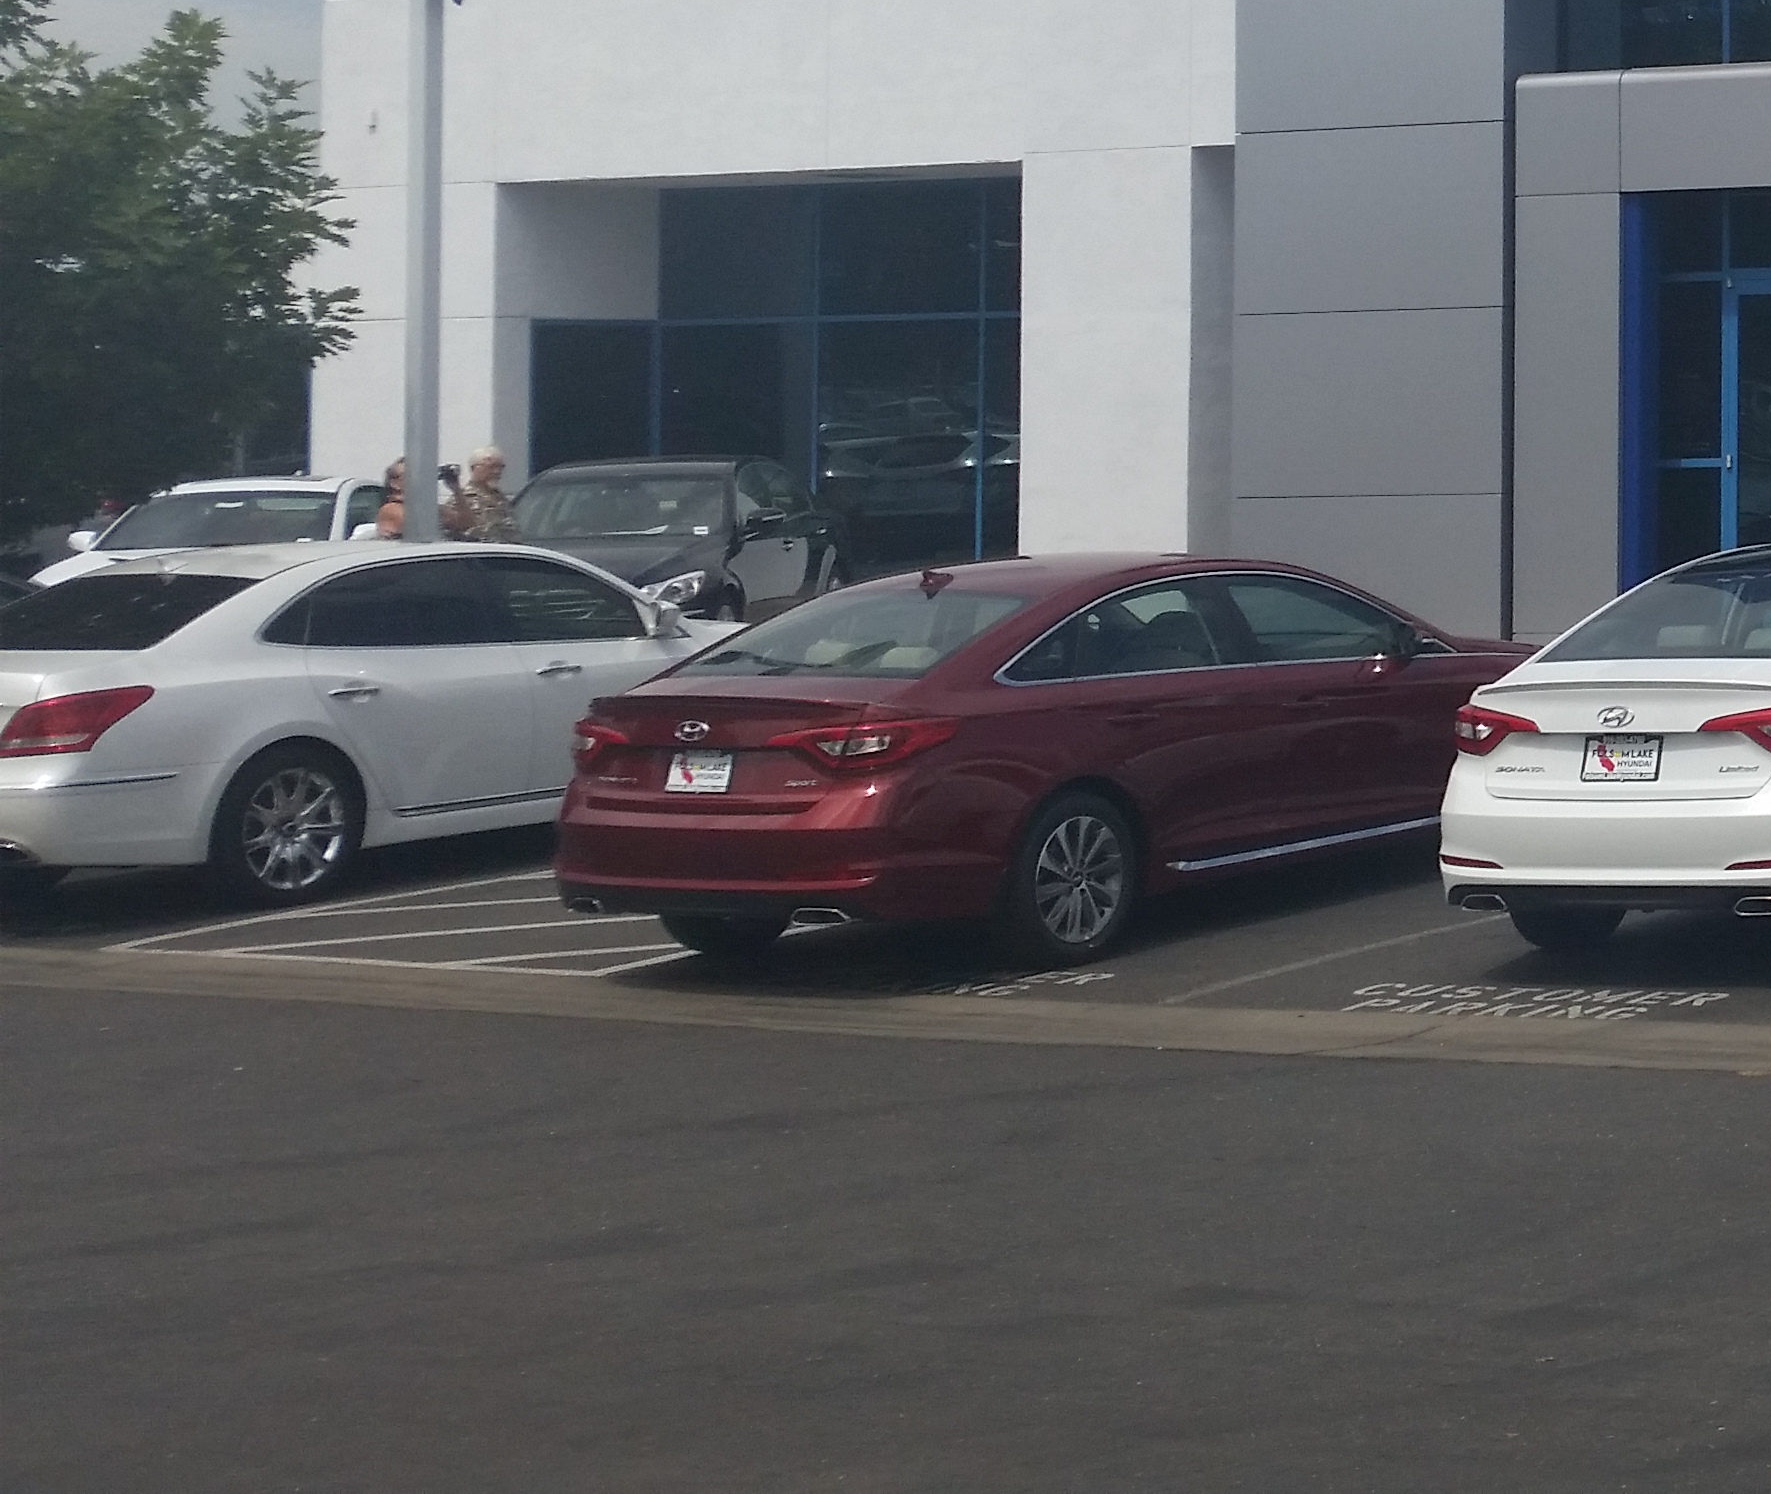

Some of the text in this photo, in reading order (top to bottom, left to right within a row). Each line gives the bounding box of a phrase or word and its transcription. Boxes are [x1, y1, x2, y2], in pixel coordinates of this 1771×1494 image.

[1631, 749, 1654, 758] LAKE
[1617, 760, 1653, 768] HYUNDAI
[1352, 982, 1731, 1007] CUSTOMER
[1341, 997, 1649, 1021] PARKING
